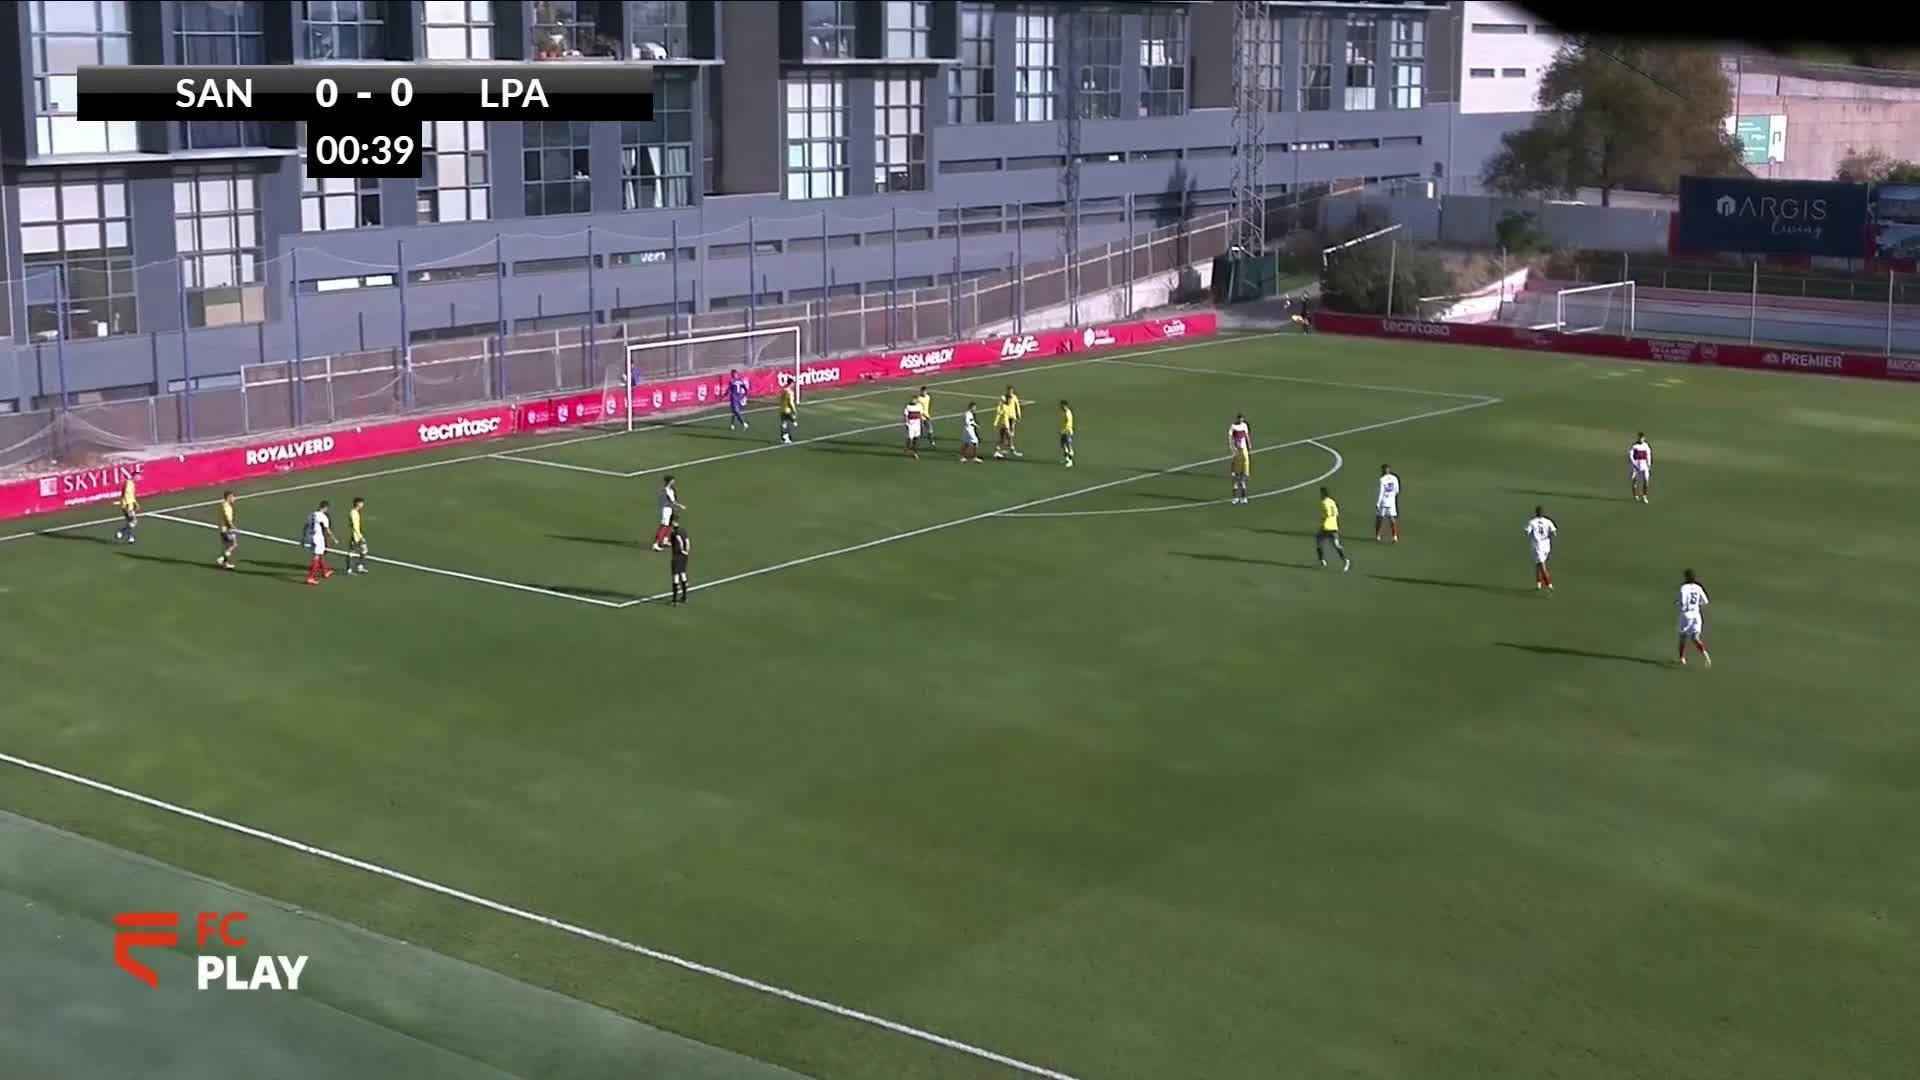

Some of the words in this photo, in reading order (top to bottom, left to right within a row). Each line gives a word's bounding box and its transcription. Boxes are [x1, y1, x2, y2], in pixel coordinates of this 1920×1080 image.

[1738, 196, 1827, 220] ARGIS
[1781, 351, 1843, 369] PREMIER
[246, 437, 335, 465] ROYALVERD
